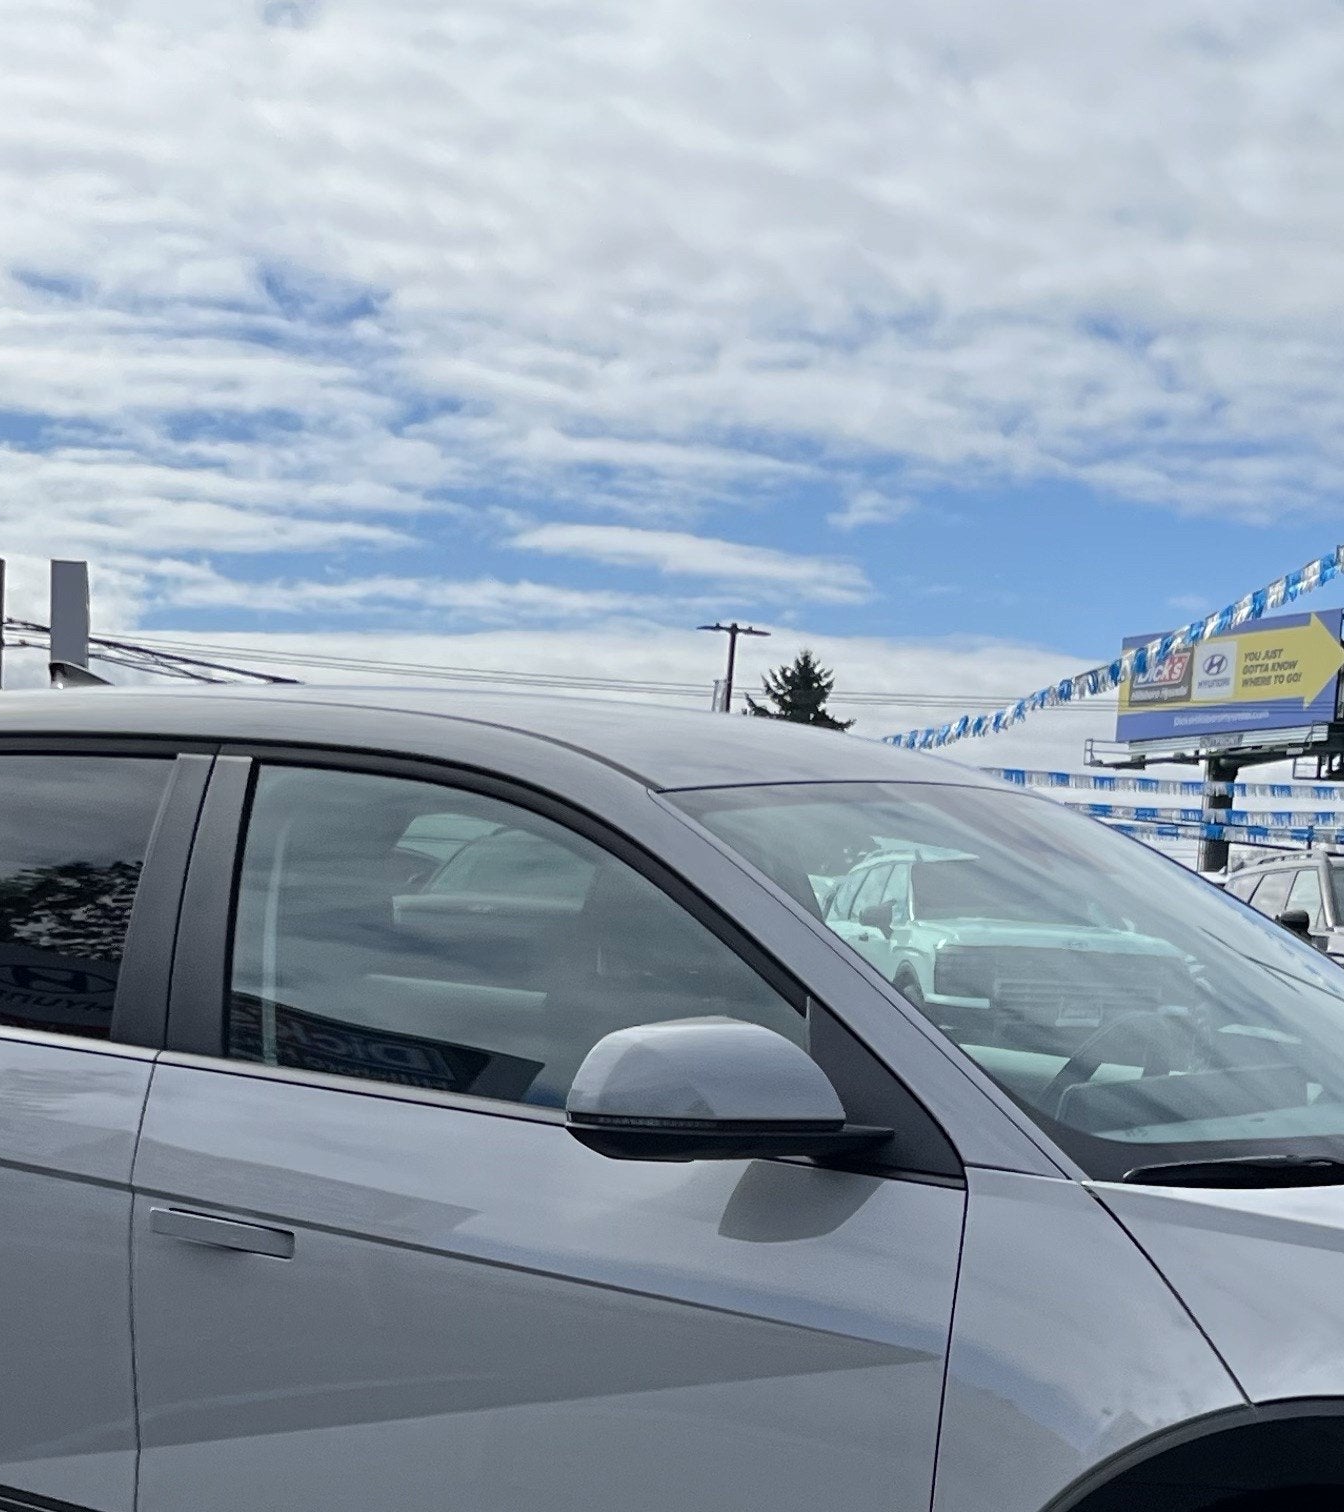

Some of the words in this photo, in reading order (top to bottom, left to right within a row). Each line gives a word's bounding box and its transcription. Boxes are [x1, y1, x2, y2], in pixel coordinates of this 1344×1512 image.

[1244, 650, 1262, 662] YOU
[1262, 648, 1284, 660] JUST
[1242, 663, 1269, 675] GOTTA
[1270, 660, 1299, 672] KNOW
[1242, 675, 1272, 687] WHERE
[1273, 674, 1285, 684] TO
[1286, 672, 1303, 683] GO!
